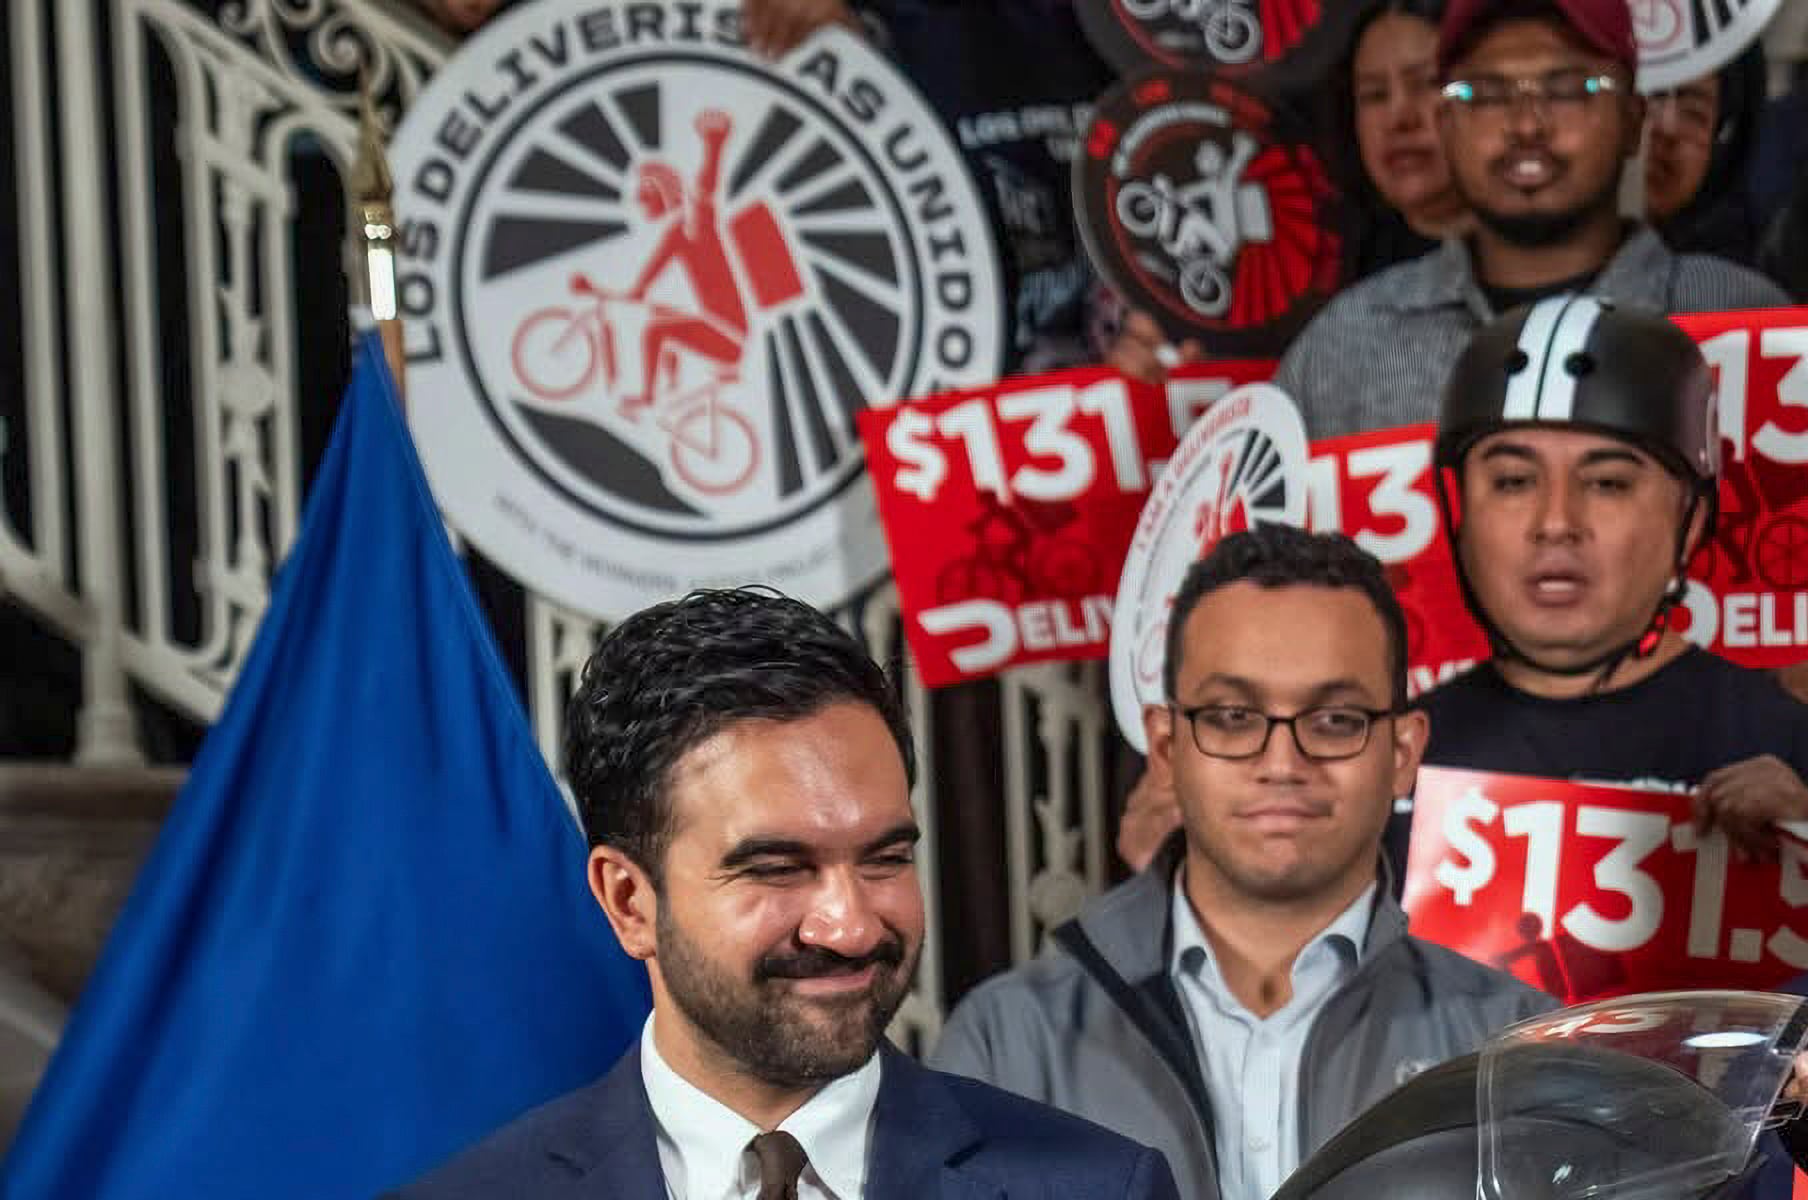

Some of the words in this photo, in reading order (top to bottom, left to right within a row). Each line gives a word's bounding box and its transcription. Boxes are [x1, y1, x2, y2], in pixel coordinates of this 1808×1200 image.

[413, 3, 884, 205] DELIVERISAS
[400, 216, 443, 364] LOS
[883, 124, 974, 388] UNIDO
